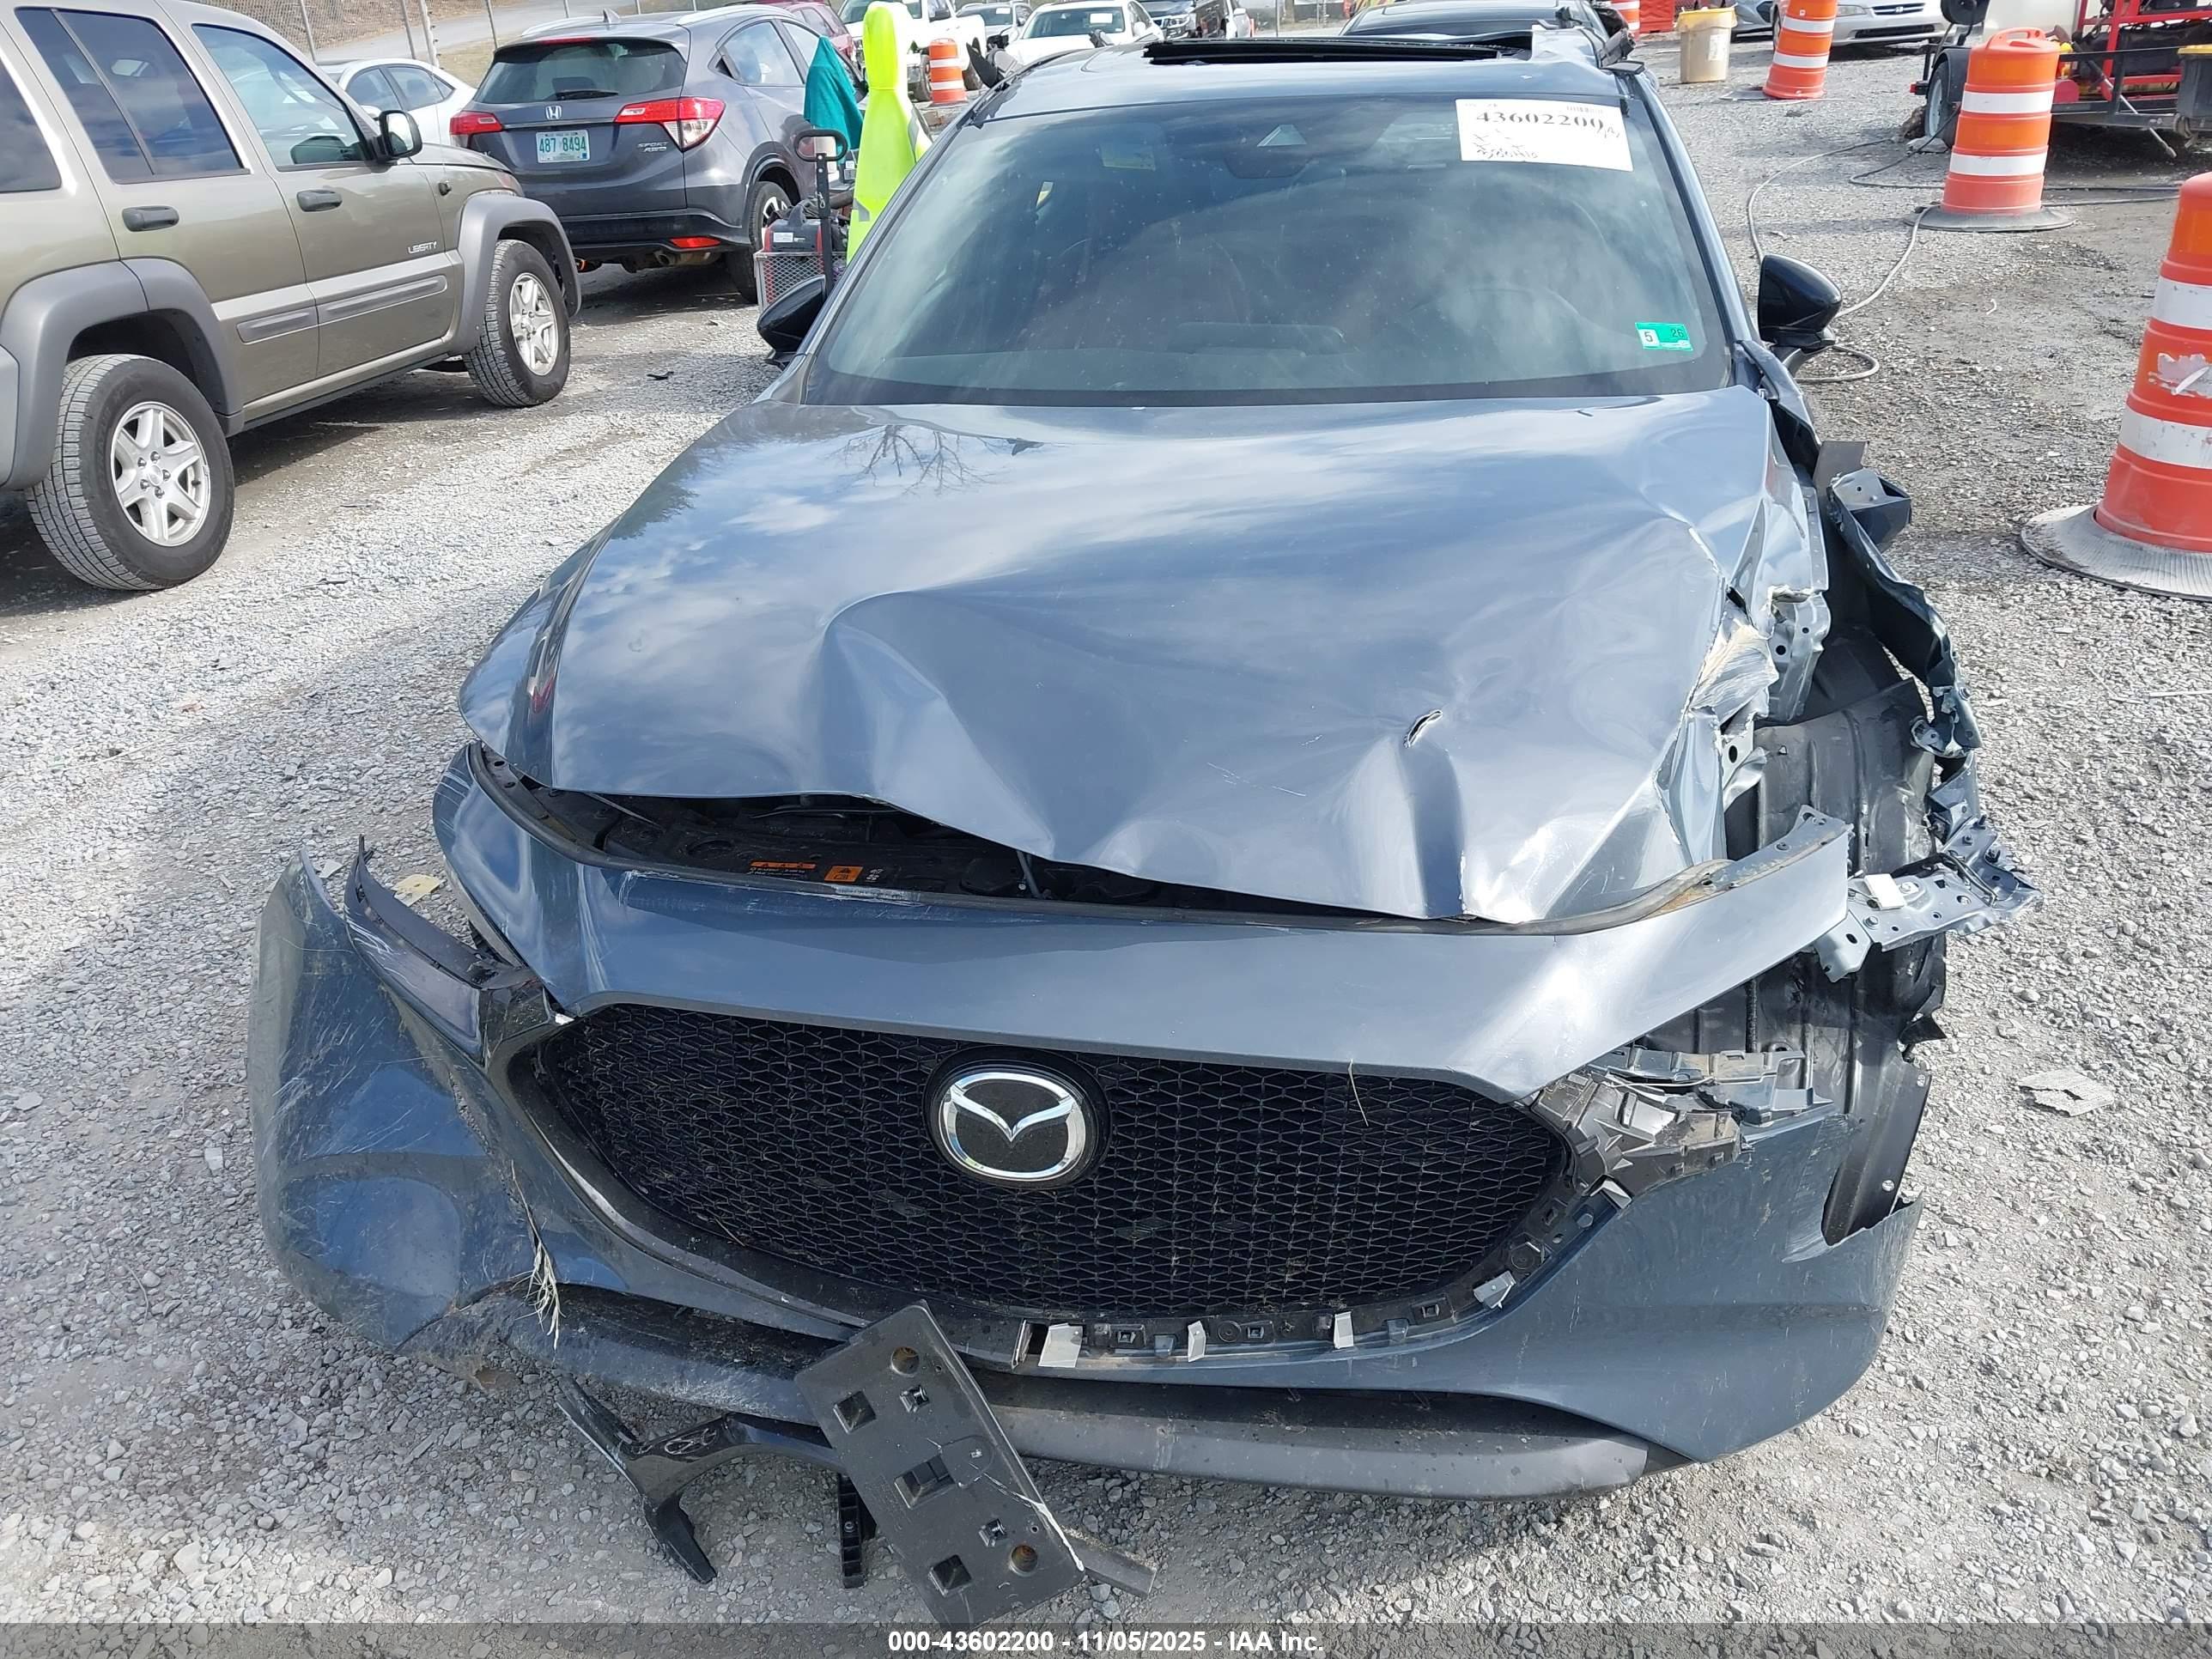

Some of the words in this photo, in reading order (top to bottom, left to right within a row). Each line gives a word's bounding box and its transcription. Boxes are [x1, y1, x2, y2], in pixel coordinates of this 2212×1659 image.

[1476, 112, 1604, 132] 43602200
[539, 137, 556, 153] 487
[562, 136, 586, 152] 8494
[407, 240, 437, 254] LIBERTY
[1644, 331, 1654, 343] 5
[1670, 328, 1684, 337] 26
